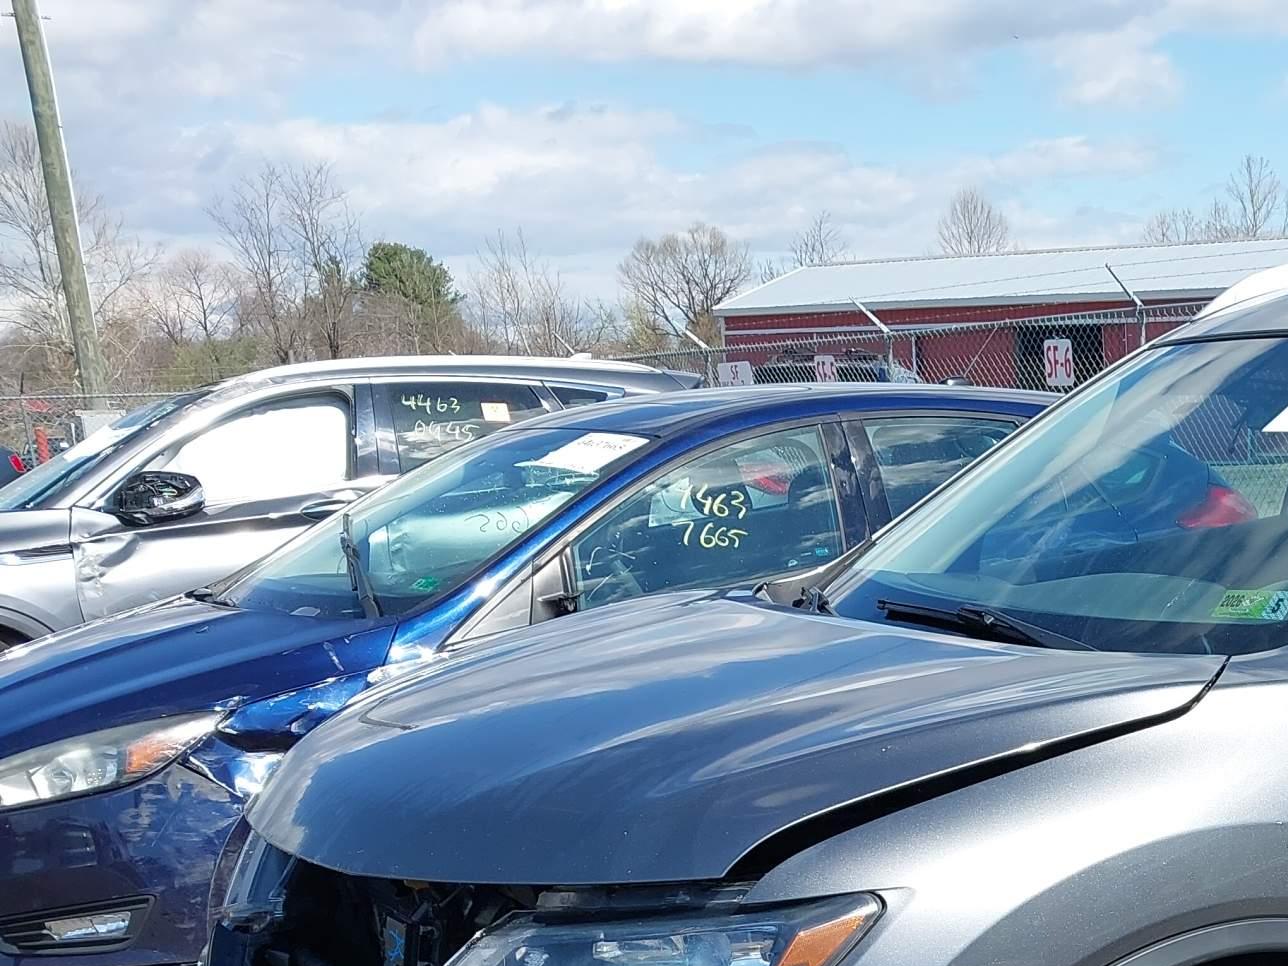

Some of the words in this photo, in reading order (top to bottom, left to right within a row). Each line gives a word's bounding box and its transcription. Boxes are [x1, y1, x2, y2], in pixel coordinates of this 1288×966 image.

[1046, 345, 1072, 379] SF-6
[401, 394, 460, 415] 4463
[672, 483, 747, 519] 4463
[672, 519, 748, 548] 7665
[1272, 598, 1284, 613] 5
